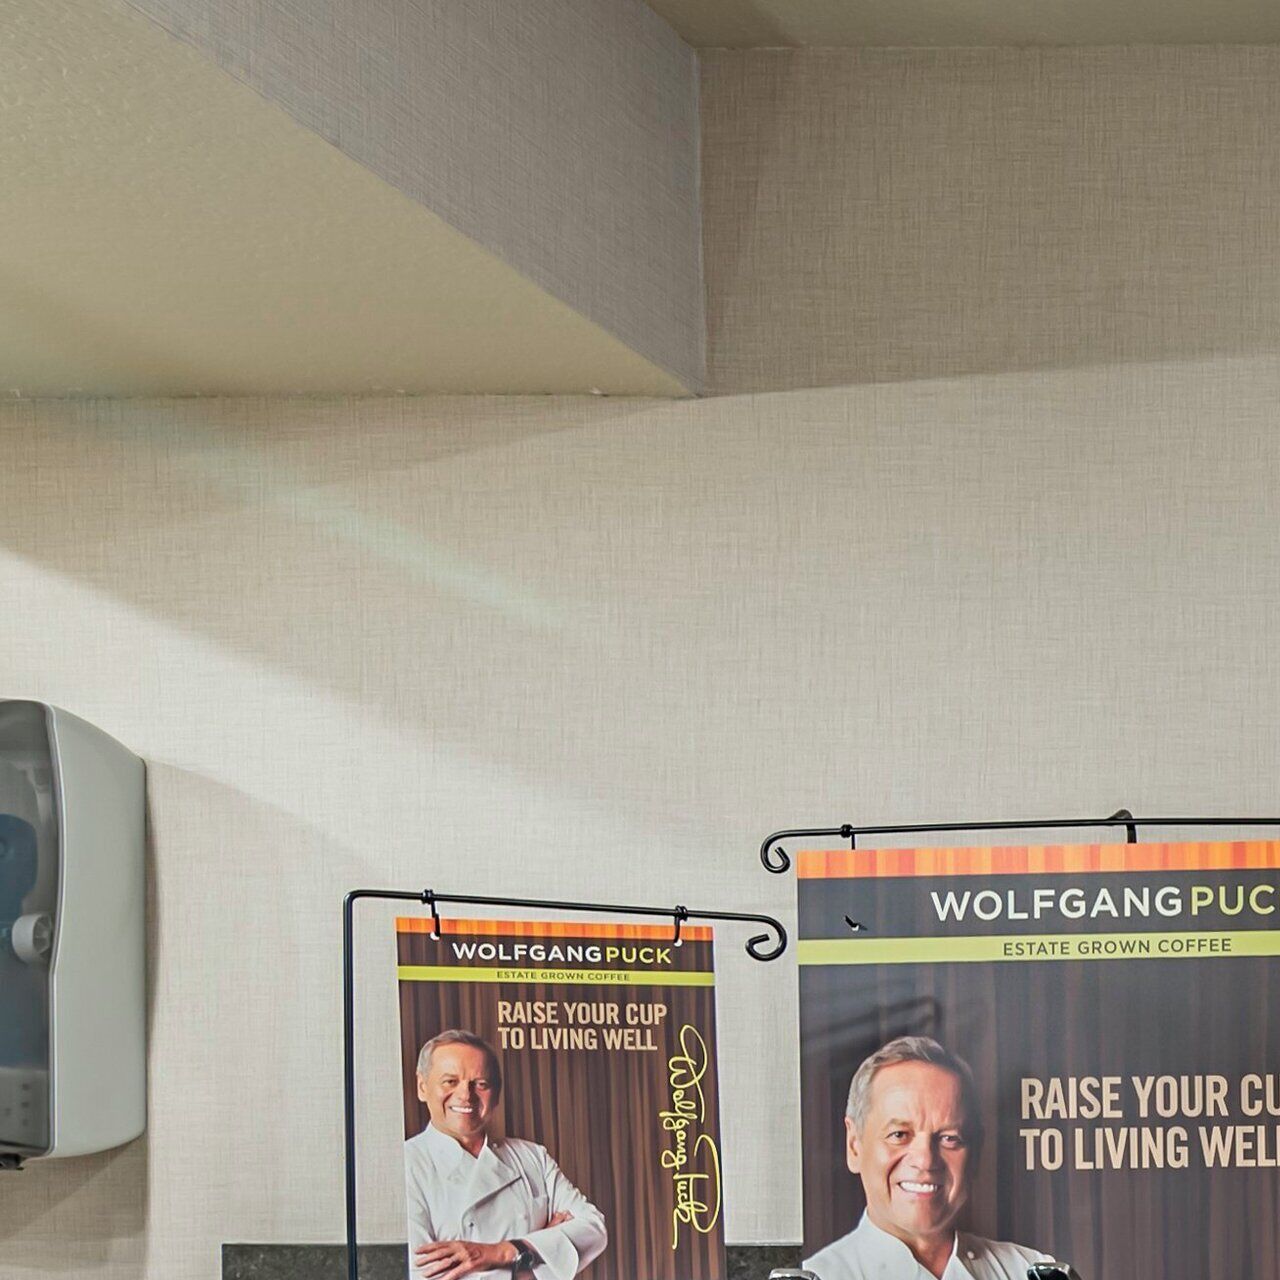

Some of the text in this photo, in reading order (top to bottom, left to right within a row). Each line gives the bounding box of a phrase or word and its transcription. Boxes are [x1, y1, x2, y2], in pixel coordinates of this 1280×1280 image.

[1003, 938, 1232, 956] ESTATE GROWN COFFEE
[496, 970, 630, 982] ESTATE GROWN COFFEE
[498, 1001, 668, 1026] RAISE YOUR CUP
[497, 1027, 658, 1051] TO LIVING WELL
[1021, 1076, 1123, 1120] RAISE
[1132, 1075, 1229, 1118] YOUR
[1020, 1128, 1063, 1170] TO
[1075, 1126, 1188, 1169] LIVING
